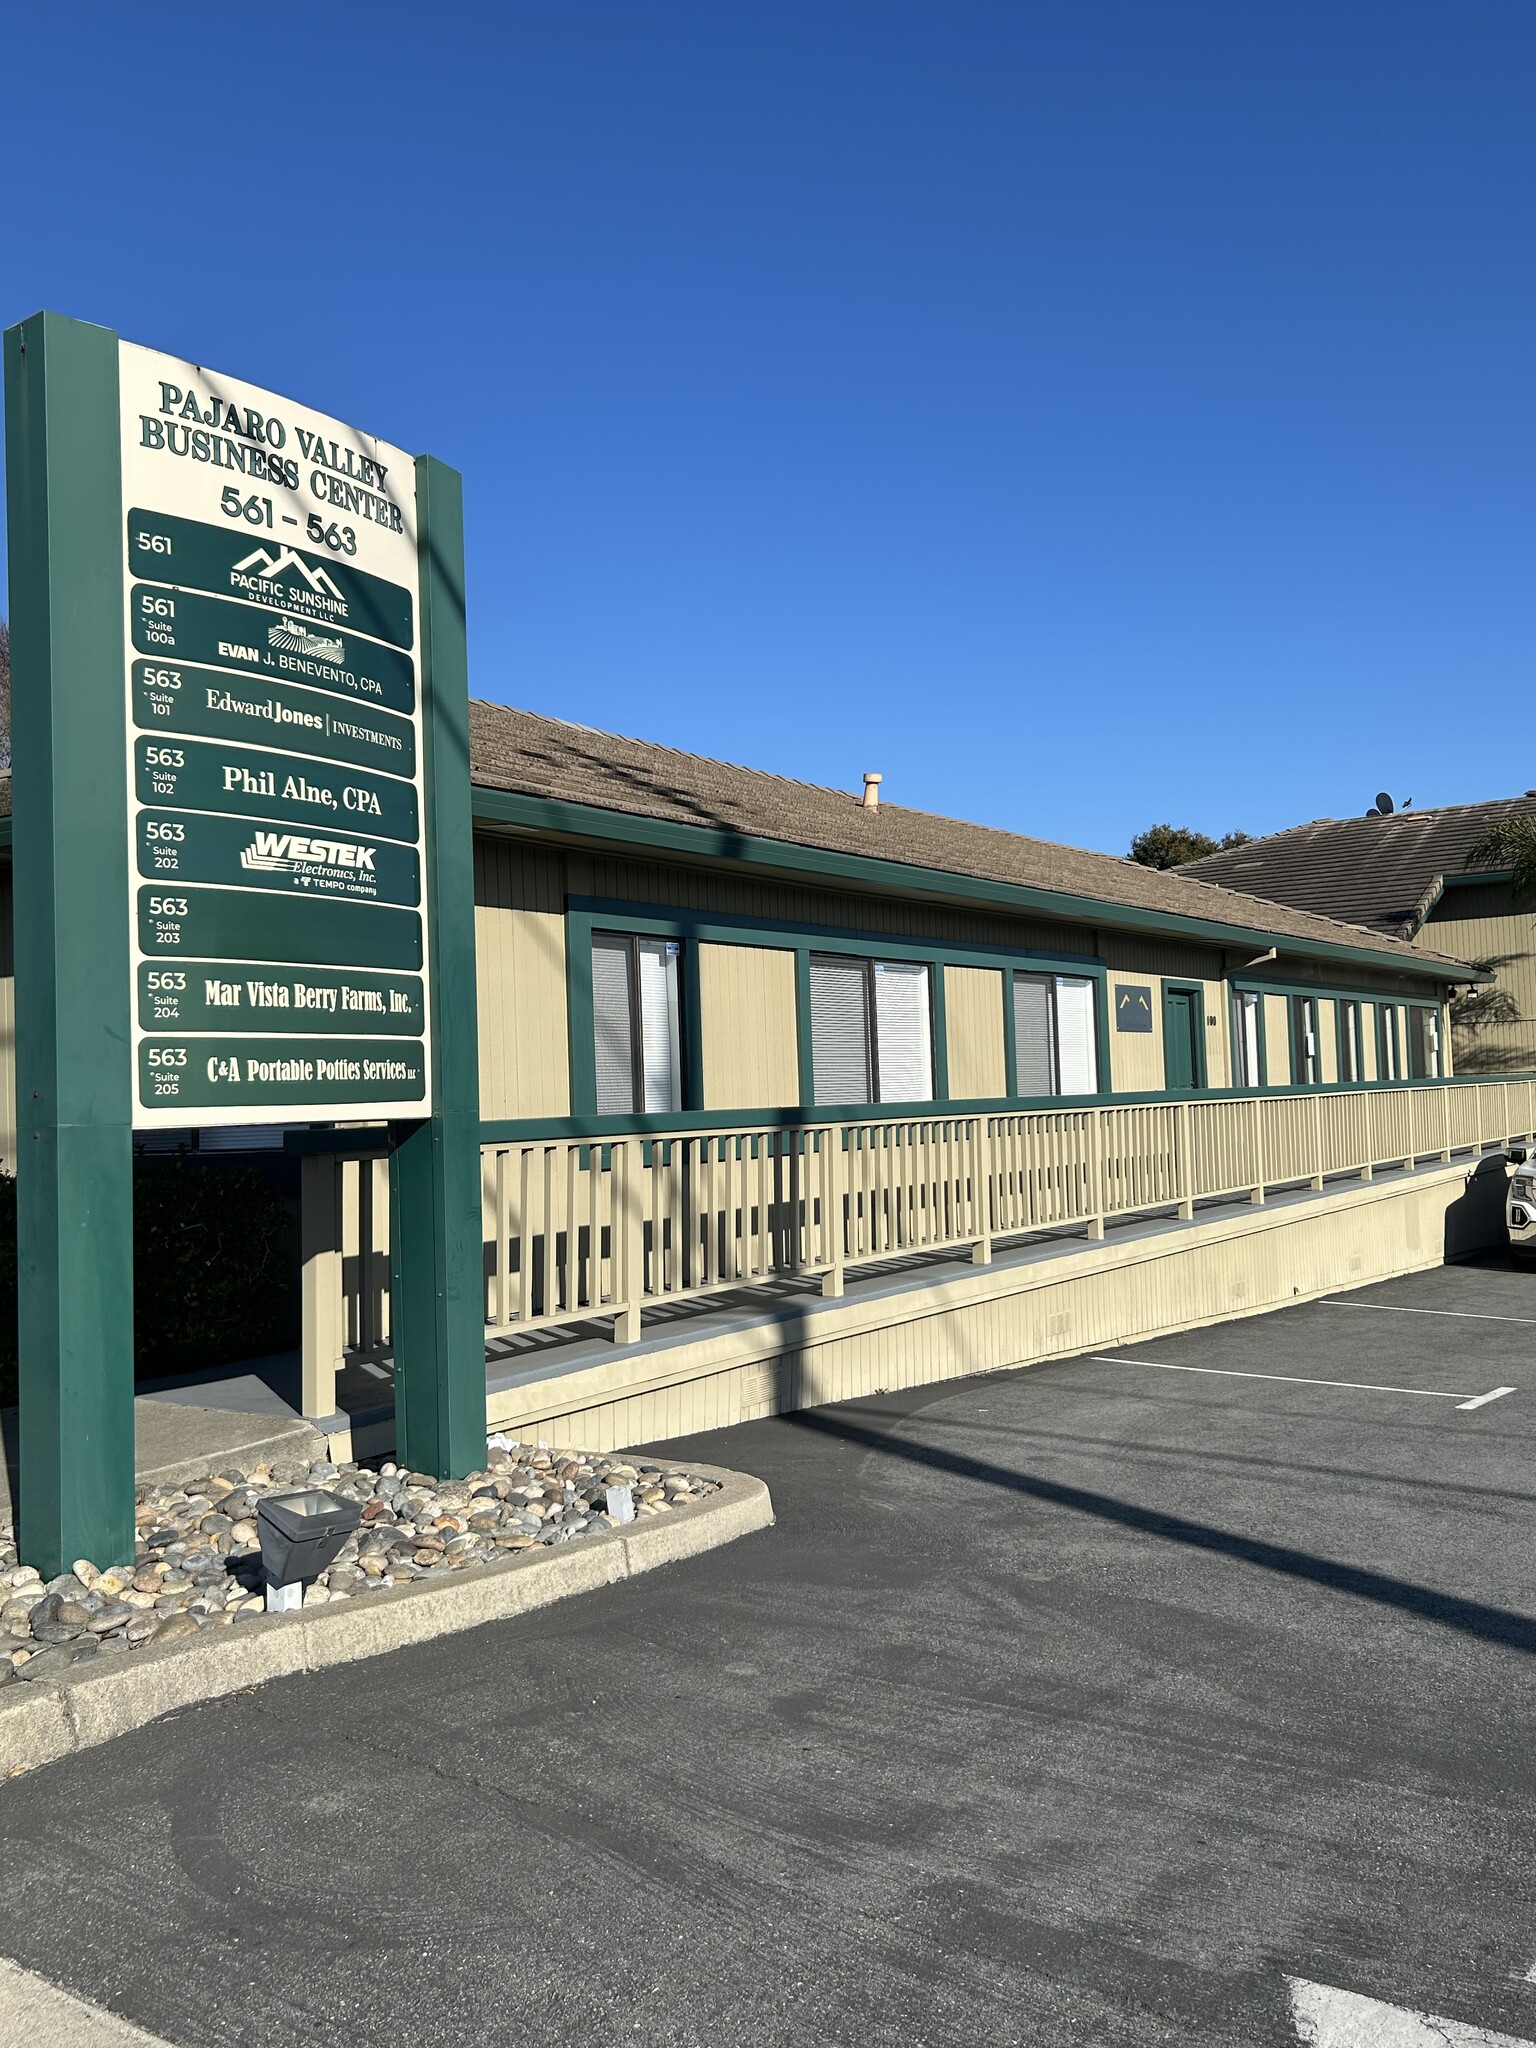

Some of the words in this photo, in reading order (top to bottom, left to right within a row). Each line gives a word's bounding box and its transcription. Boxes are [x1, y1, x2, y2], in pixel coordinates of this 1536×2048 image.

[159, 381, 286, 449] PAJARO
[295, 427, 388, 493] VALLEY
[139, 415, 299, 490] BUSINESS
[310, 470, 403, 534] CENTER
[220, 485, 273, 528] 561
[306, 512, 357, 556] 563
[138, 532, 172, 555] 561
[230, 571, 284, 597] PACIFIC
[289, 588, 349, 617] SUNSHINE
[141, 595, 175, 618] 561
[248, 592, 317, 619] DEVELOPMENT
[319, 611, 335, 622] LLC
[148, 620, 172, 632] Suite
[145, 631, 175, 646] 100a
[218, 641, 259, 662] EVAN
[263, 652, 275, 666] J.
[279, 656, 358, 690] BENEVENTO,
[360, 677, 383, 695] CPA
[143, 668, 182, 690] 563
[150, 692, 174, 704] Suite
[152, 703, 170, 716] 101
[332, 720, 402, 751] INVESTMENTS
[146, 747, 185, 767] 563
[152, 769, 177, 782] Suite
[152, 781, 174, 794] 102
[222, 766, 276, 796] Phil
[282, 777, 338, 810] Alne,
[343, 786, 382, 815] CPA
[146, 821, 185, 842] 563
[153, 846, 178, 856] Suite
[255, 831, 377, 870] WESTEK
[154, 856, 179, 869] 202
[293, 862, 356, 882] Electronics,
[358, 870, 377, 883] Inc.
[313, 879, 345, 890] TEMPO
[346, 884, 377, 896] company
[149, 897, 188, 916] 563
[156, 920, 181, 931] Suite
[156, 932, 180, 944] 203
[147, 972, 187, 991] 563
[154, 995, 179, 1006] Suite
[205, 979, 242, 1007] Mar
[246, 980, 289, 1009] Vista
[294, 983, 338, 1013] Berry
[341, 985, 386, 1015] Farms,
[389, 989, 411, 1014] Inc.
[154, 1007, 180, 1019] 204
[148, 1048, 188, 1067] 563
[155, 1072, 180, 1082] Suite
[207, 1055, 241, 1082] C&A
[247, 1058, 313, 1082] Portable
[316, 1058, 361, 1080] Potties
[363, 1058, 406, 1080] Services
[154, 1083, 179, 1095] 205
